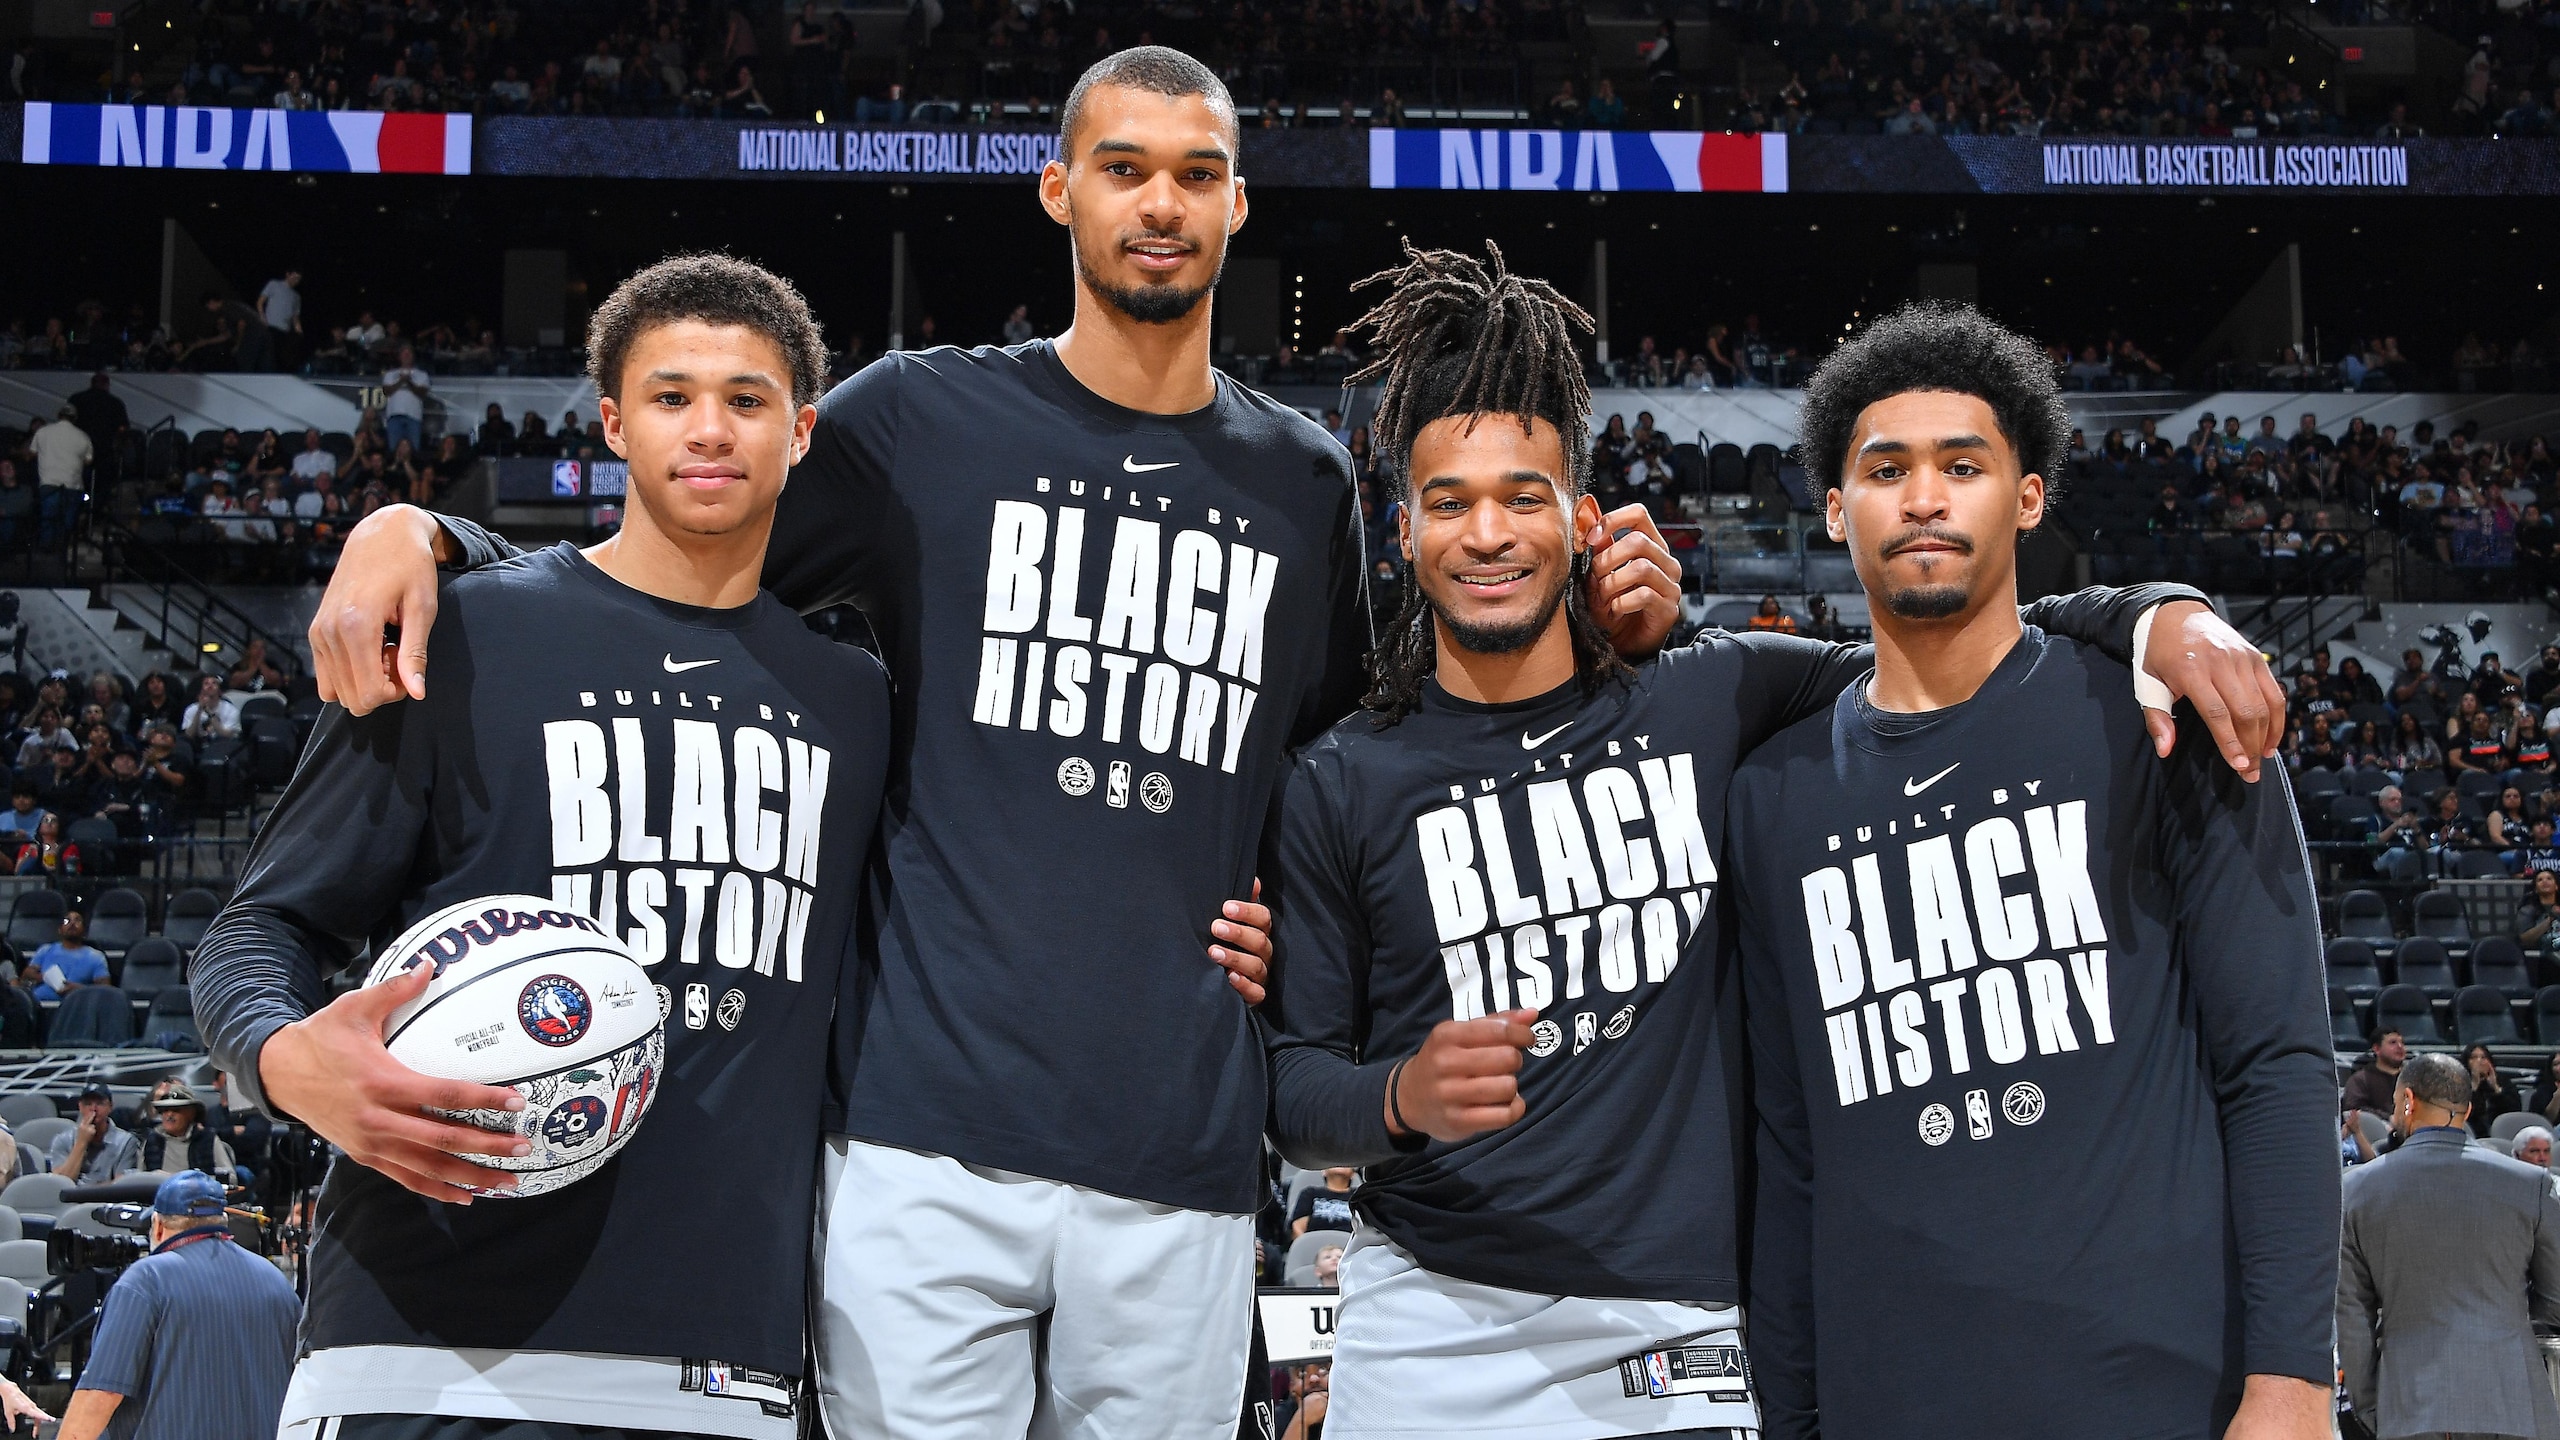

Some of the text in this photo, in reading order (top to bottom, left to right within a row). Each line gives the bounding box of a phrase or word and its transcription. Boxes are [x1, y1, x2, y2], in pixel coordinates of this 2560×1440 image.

[739, 129, 1062, 174] NATIONAL BASKETBALL ASSOCI
[2043, 145, 2408, 186] NATIONAL BASKETBALL ASSOCIATION
[591, 461, 628, 474] NATION
[1036, 477, 1249, 533] BUILT BY
[983, 499, 1279, 685] BLACK
[579, 689, 801, 728] BUILT BY
[972, 637, 1259, 774] HISTORY
[1607, 734, 1650, 756] BY
[543, 717, 831, 888] BLACK
[1827, 779, 2042, 852] BUILT BY
[1416, 752, 1718, 944] BLACK
[1801, 799, 2108, 1011] BLACK
[401, 908, 609, 981] Wilson
[1440, 888, 1712, 1022] HISTORY
[523, 978, 586, 1017] LOS ANGELES
[1825, 949, 2115, 1106] HISTORY
[454, 1021, 506, 1047] OFFICIAL ALL-STAR
[1672, 1360, 1683, 1370] 48
